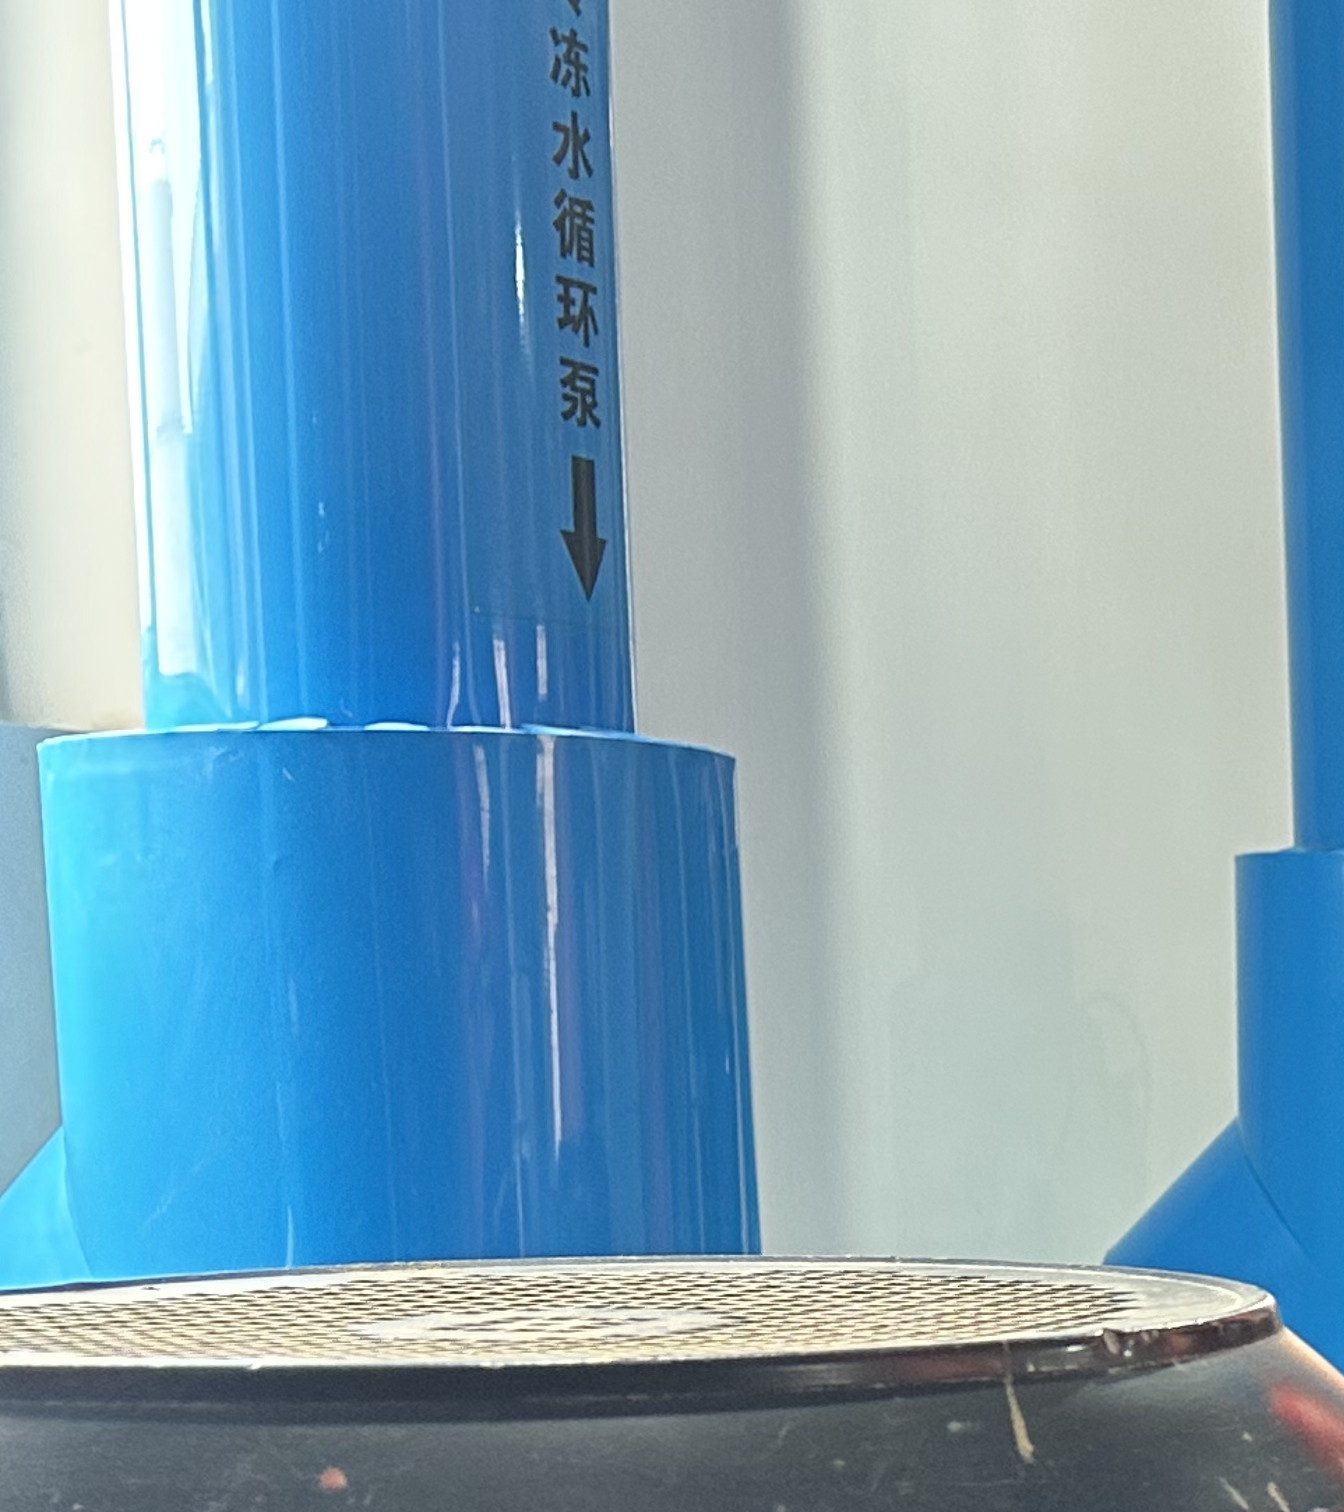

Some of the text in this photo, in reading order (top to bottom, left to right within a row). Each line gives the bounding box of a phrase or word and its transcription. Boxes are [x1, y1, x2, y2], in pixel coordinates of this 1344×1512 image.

[549, 0, 601, 429] 冻水循环泵
